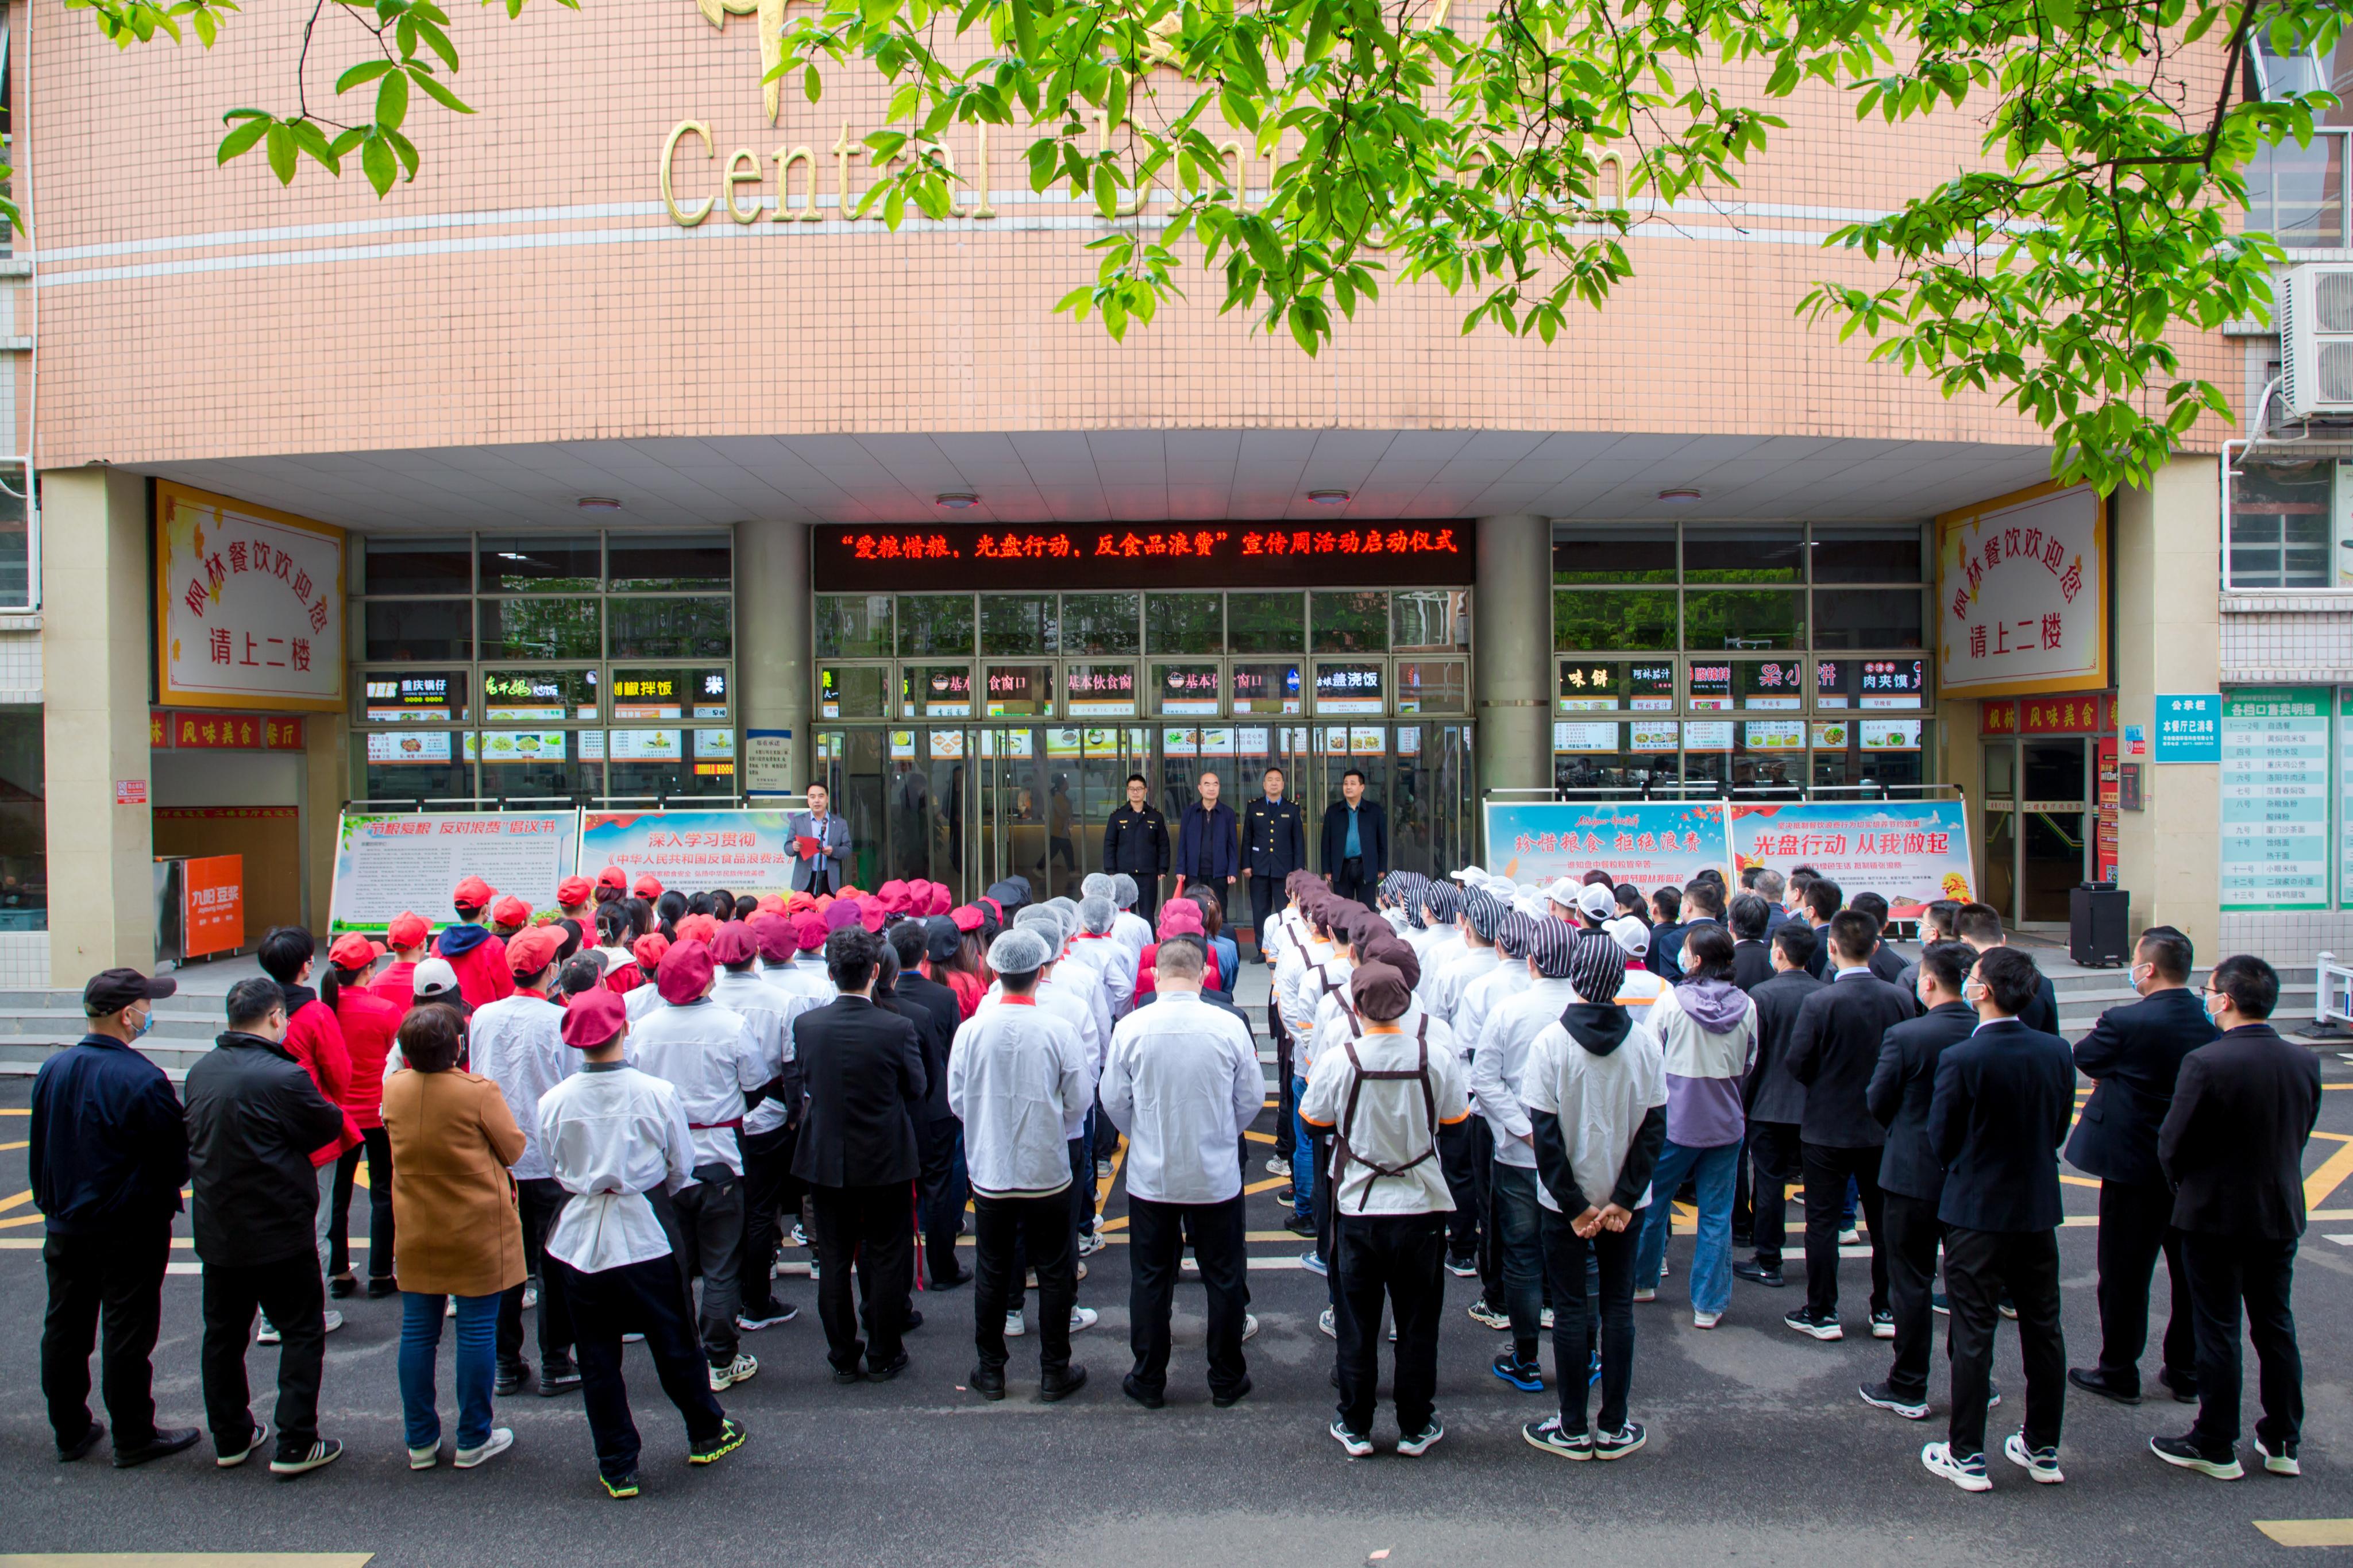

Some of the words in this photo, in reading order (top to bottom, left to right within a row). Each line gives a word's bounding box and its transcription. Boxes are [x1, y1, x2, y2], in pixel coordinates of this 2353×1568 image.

[1092, 109, 1405, 247] Dini
[1242, 528, 1459, 555] 宣传周活动启动仪式
[1953, 527, 2082, 621] 枫林餐饮欢迎您
[184, 539, 327, 635] 枫林餐饮欢迎您
[1970, 612, 2062, 659] 请上二楼
[209, 627, 311, 672] 请上二楼
[401, 679, 447, 692] 重庆锅仔
[1068, 673, 1132, 690] 基本伙食窗
[1233, 672, 1262, 689] 窗口
[1863, 674, 1908, 688] 肉夹馍
[2171, 700, 2207, 710] 公示栏
[2231, 703, 2316, 716] 各档口售卖明细
[2030, 702, 2094, 728] 风味美食
[2163, 720, 2214, 733] 本餐厅已消毒
[2267, 721, 2290, 730] 自选餐
[183, 720, 253, 745] 风味美食
[2236, 735, 2251, 743] 三号
[2236, 748, 2251, 756] 四号
[2236, 761, 2251, 769] 五号
[2236, 787, 2251, 795] 七号
[2236, 800, 2251, 808] 八号
[2236, 826, 2250, 834] 九号
[648, 831, 757, 848] 深入学习贯彻
[1514, 832, 1606, 855] 珍惜粮食
[1614, 831, 1702, 854] 拒绝浪费
[1753, 834, 1847, 856] 光盘行动
[1855, 832, 1949, 855] 从我做起
[2235, 839, 2250, 847] 十号
[607, 853, 795, 866] 《中华人民共和国反食品浪费法》
[2232, 865, 2254, 873] 十一号
[2232, 878, 2255, 886] 十二号
[192, 885, 239, 907] 九阳豆浆
[2232, 891, 2255, 899] 十三号
